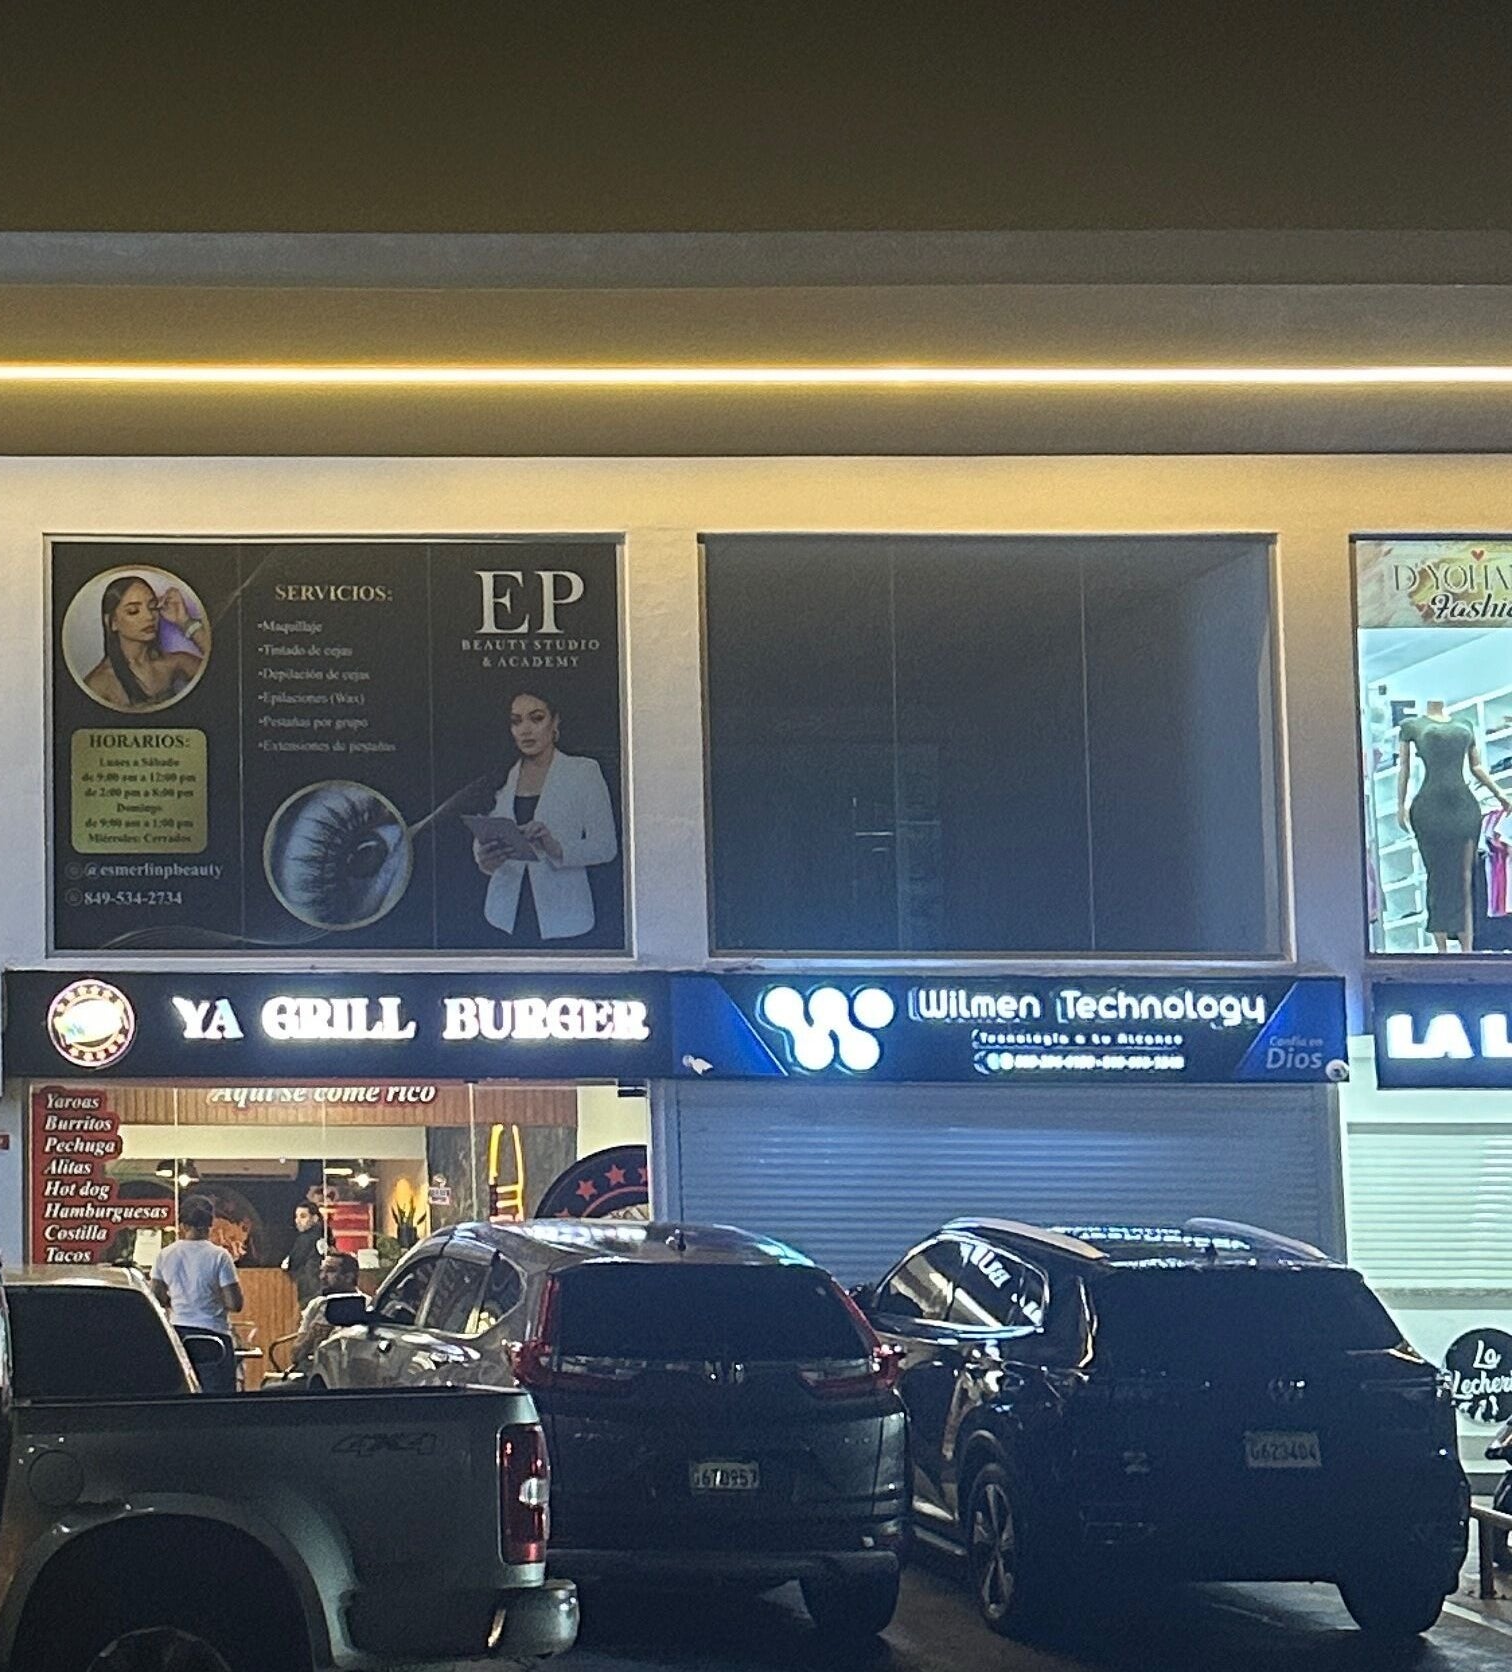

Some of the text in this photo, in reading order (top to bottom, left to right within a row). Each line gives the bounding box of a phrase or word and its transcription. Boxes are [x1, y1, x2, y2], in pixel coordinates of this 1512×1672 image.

[275, 585, 393, 601] SERVICIOS:
[473, 570, 585, 634] EP
[307, 645, 321, 656] de
[462, 639, 601, 650] BEAUTY STUDIO
[482, 656, 580, 668] & ACADEMY
[313, 717, 331, 730] por
[89, 734, 190, 749] HORARIOS:
[84, 891, 183, 905] 849-534-2734
[912, 989, 1267, 1027] Wilmen Technology
[172, 995, 651, 1042] YA GRILL BURGER
[1387, 1013, 1475, 1058] LA
[1266, 1047, 1322, 1069] Dios
[46, 1093, 100, 1109] Yaroas
[279, 1087, 306, 1102] se
[314, 1087, 380, 1102] come
[386, 1086, 436, 1103] rico
[45, 1115, 113, 1131] Burritos
[45, 1137, 116, 1156] Pechuga
[44, 1158, 93, 1175] Alitas
[44, 1181, 111, 1200] Hot dog
[44, 1203, 169, 1223] Hamburguesas
[44, 1224, 107, 1241] Costilla
[46, 1247, 92, 1263] Tacos
